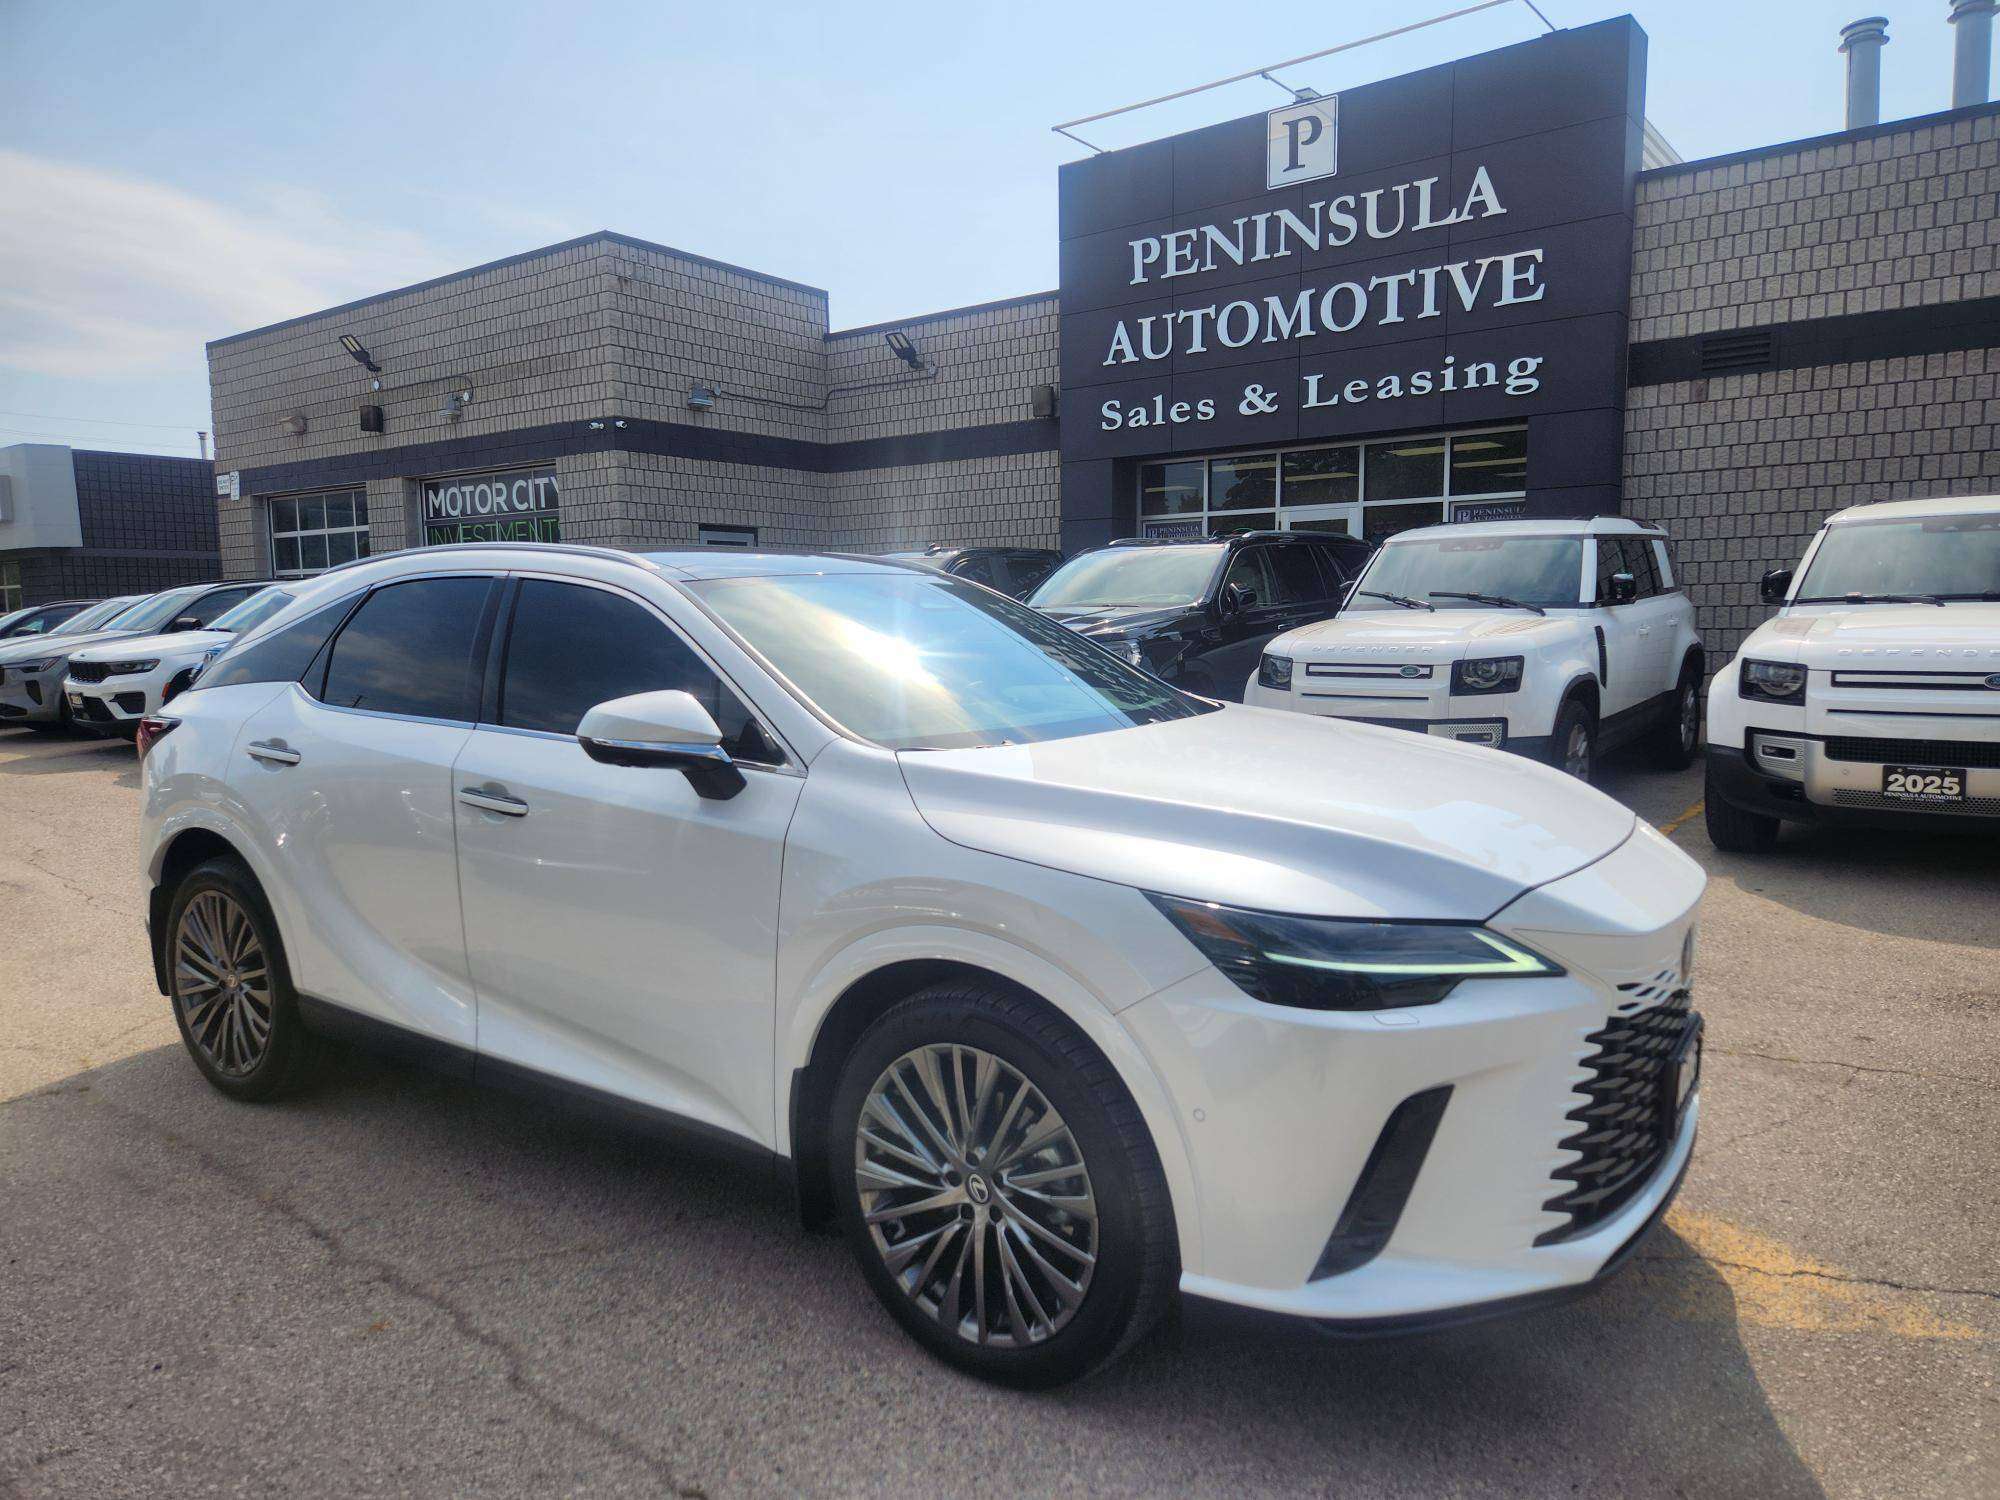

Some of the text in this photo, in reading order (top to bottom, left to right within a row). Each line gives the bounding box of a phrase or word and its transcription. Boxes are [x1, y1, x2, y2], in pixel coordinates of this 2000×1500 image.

[1282, 114, 1322, 172] P
[1128, 165, 1507, 286] PENINSULA
[1102, 248, 1546, 367] AUTOMOTIVE
[1100, 354, 1544, 431] Sales & Leasing
[428, 482, 509, 518] MOTOR
[430, 518, 560, 545] INVESTMENT
[1312, 645, 1433, 653] DEFENDER
[1887, 773, 1960, 795] 2025
[1920, 793, 1962, 801] AUTOMOTIVE
